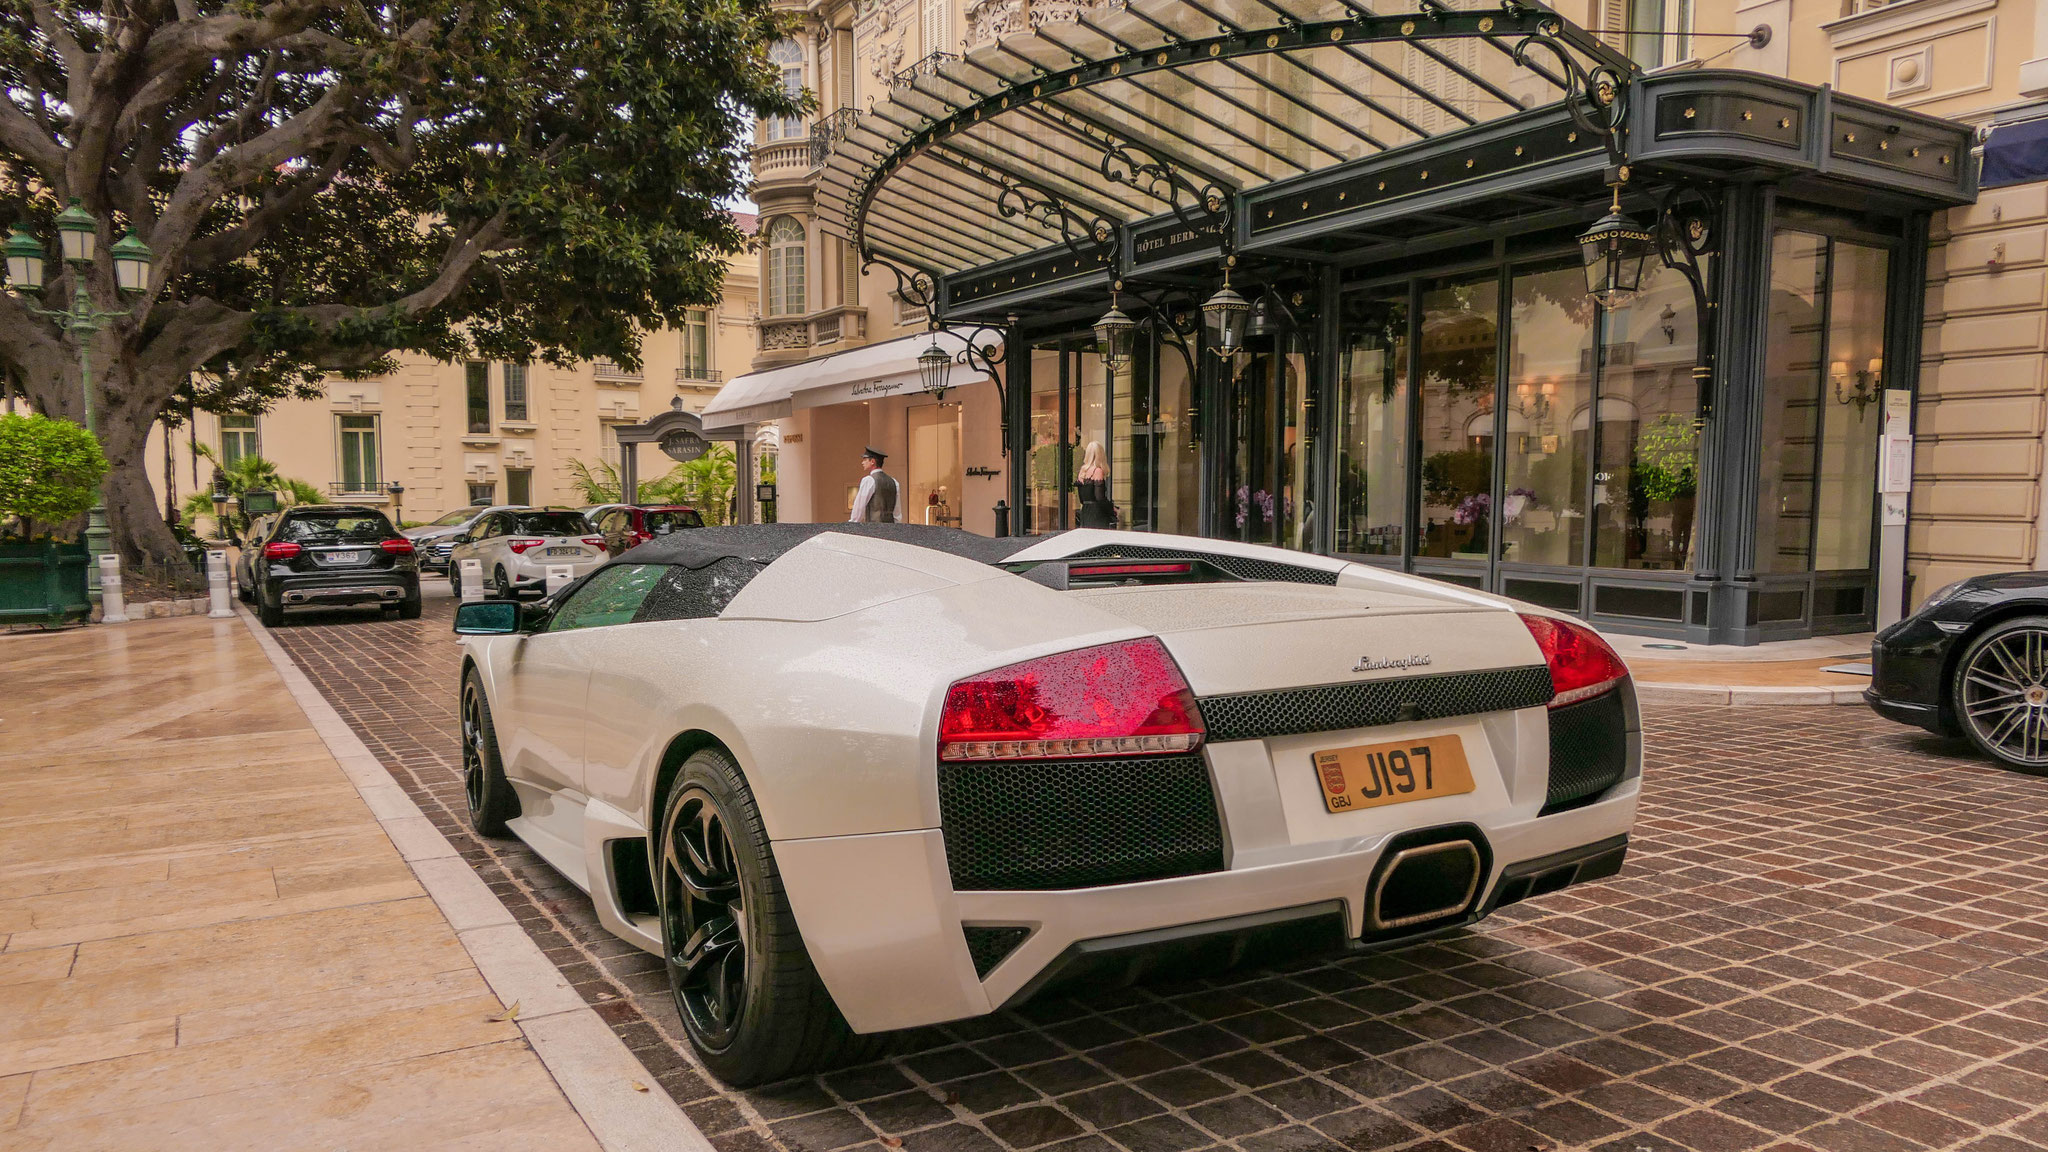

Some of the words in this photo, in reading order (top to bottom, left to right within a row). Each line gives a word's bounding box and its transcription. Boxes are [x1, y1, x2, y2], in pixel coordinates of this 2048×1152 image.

[1137, 237, 1165, 253] HÔTEL
[676, 437, 701, 445] SAFRA
[668, 446, 701, 454] SARASIN
[1352, 654, 1432, 672] Lamborghini
[1319, 754, 1338, 763] JERSEY
[1361, 746, 1433, 799] J197
[1331, 796, 1352, 809] GBJ
